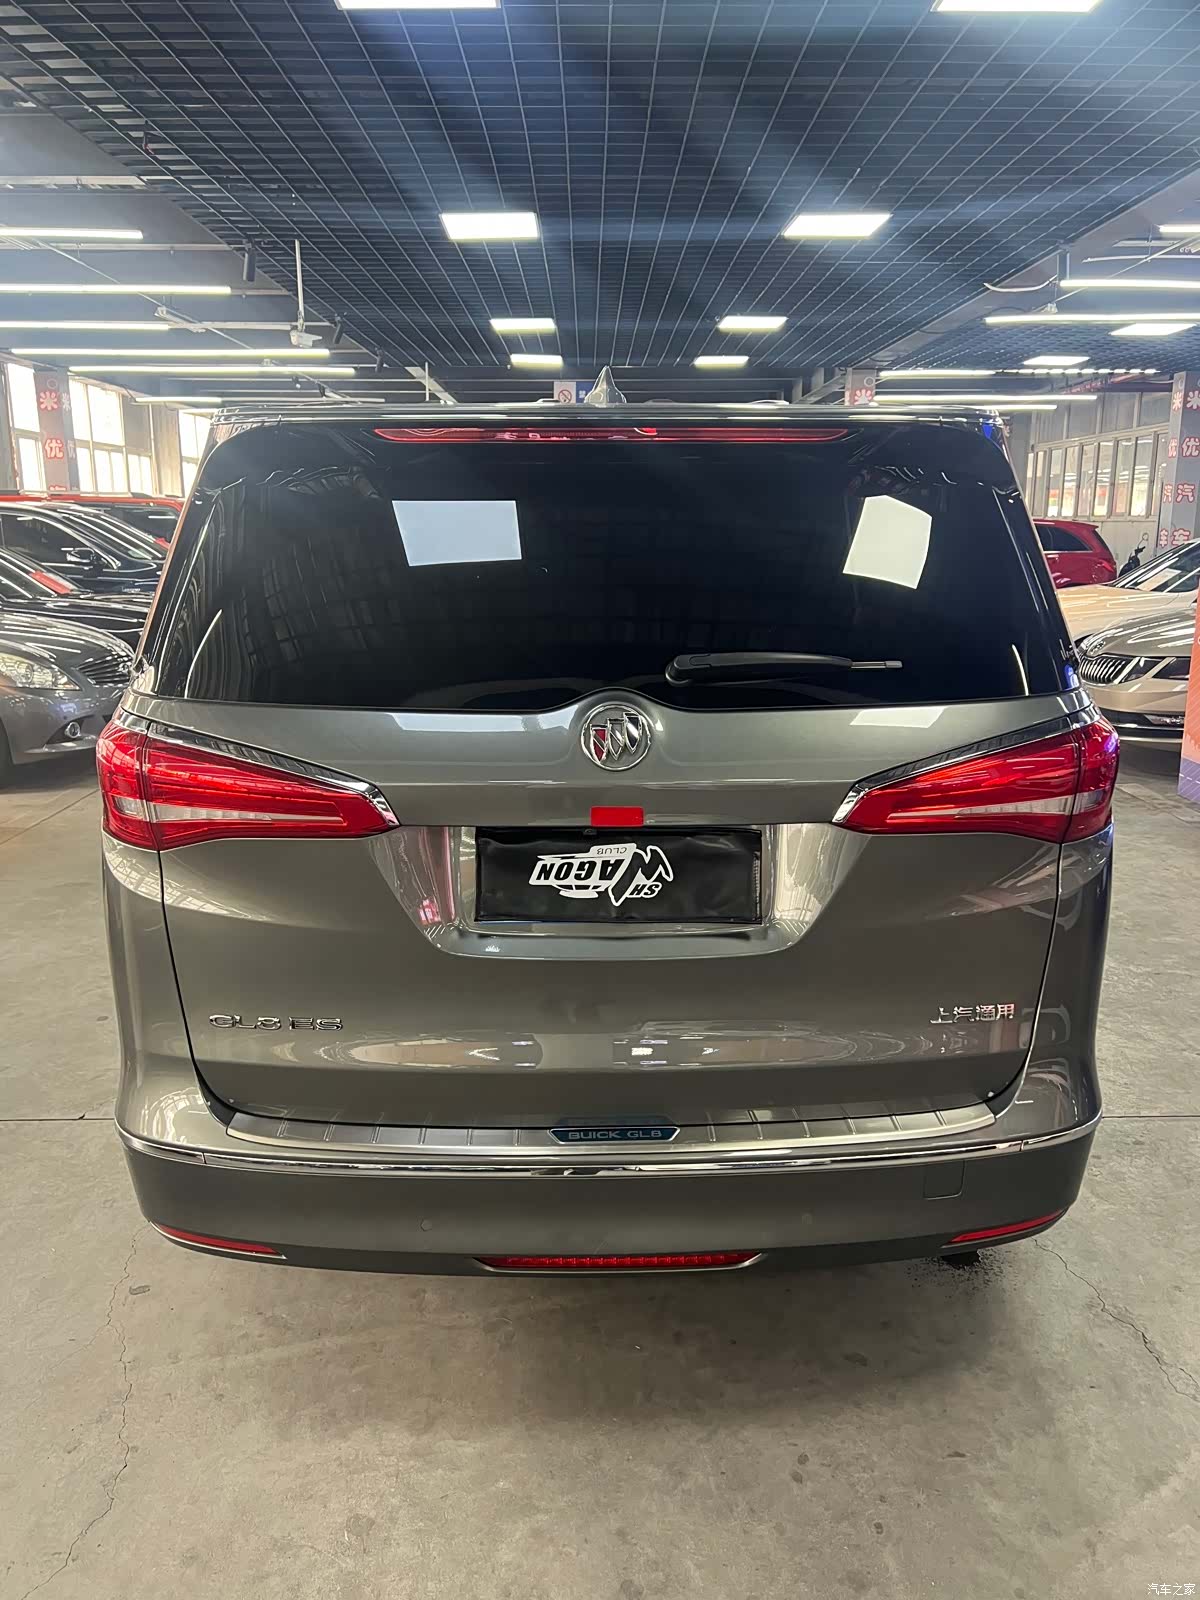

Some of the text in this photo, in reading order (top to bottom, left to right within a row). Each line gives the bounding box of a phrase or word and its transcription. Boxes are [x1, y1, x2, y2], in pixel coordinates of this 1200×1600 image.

[596, 847, 628, 855] CLUB
[929, 1003, 1016, 1024] 上汽通用
[208, 1013, 344, 1031] GL8 ES
[568, 1129, 662, 1140] BUICK GL8
